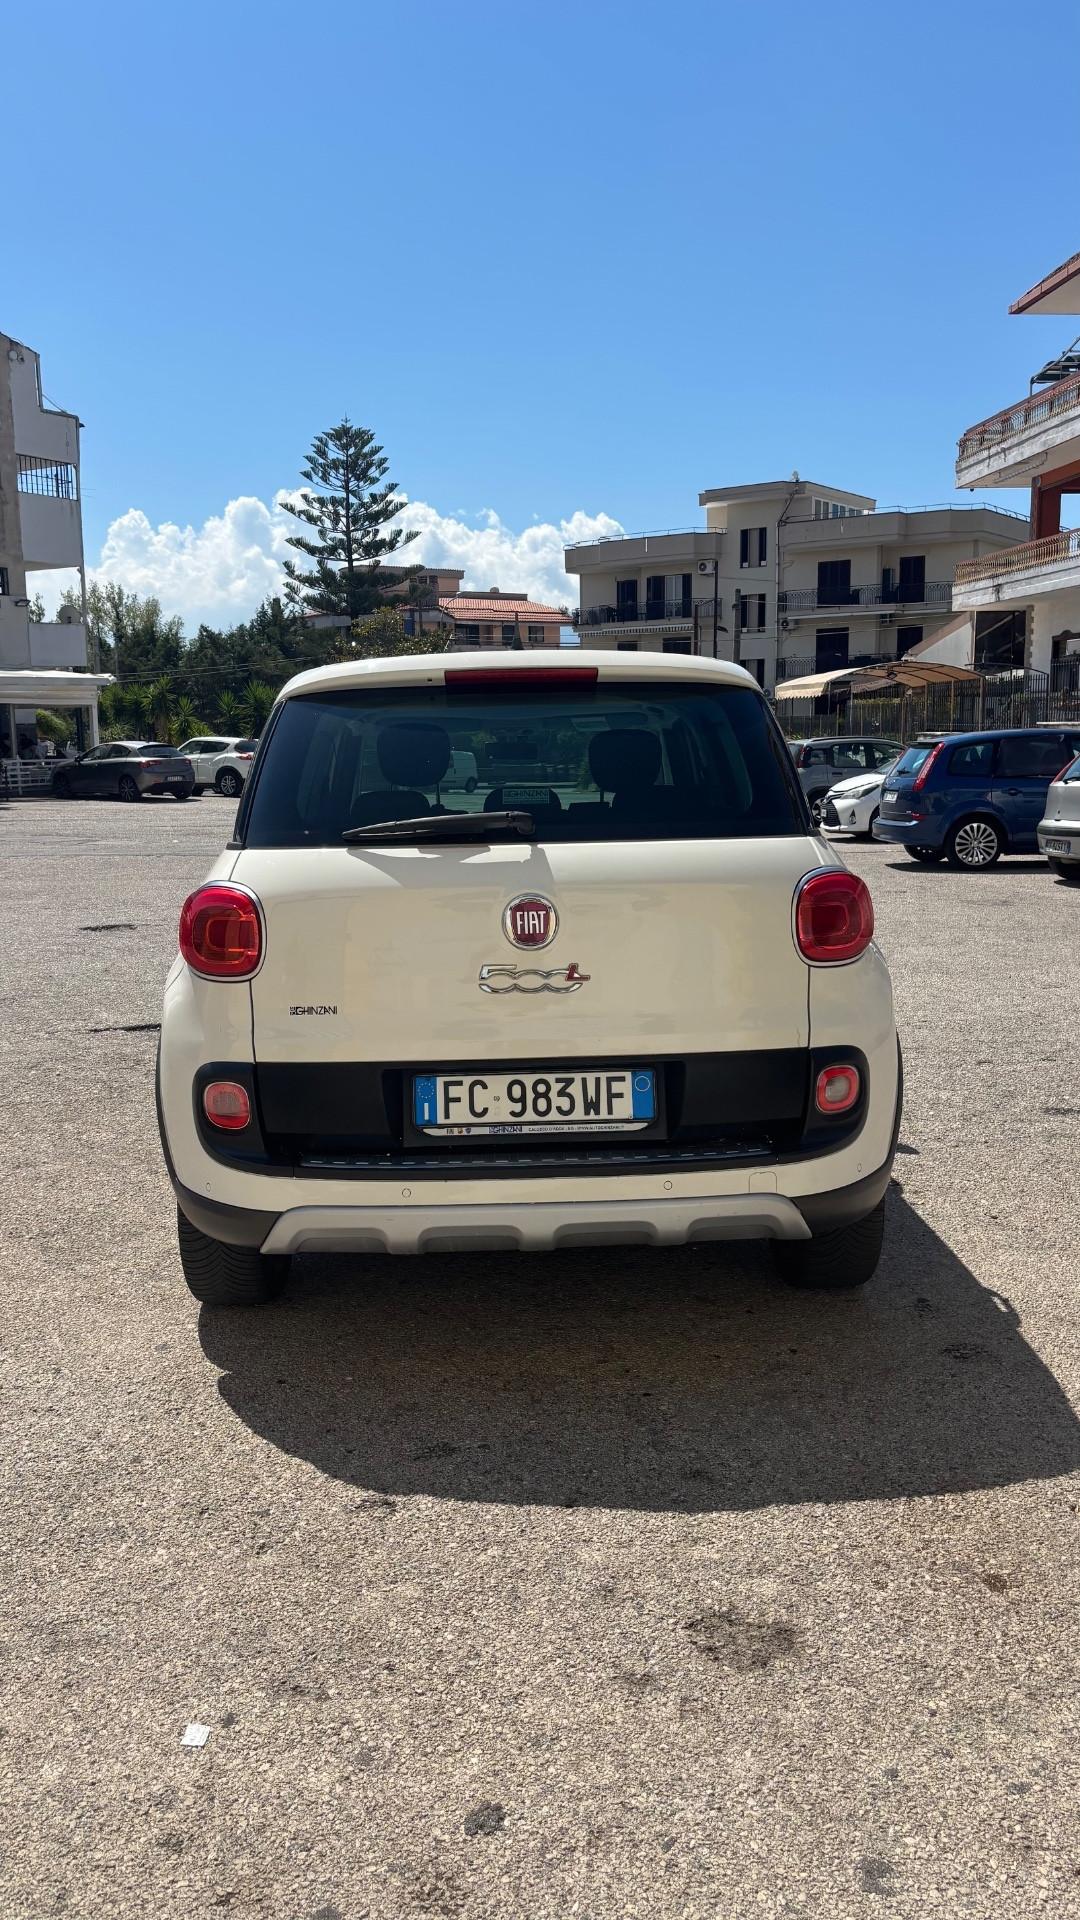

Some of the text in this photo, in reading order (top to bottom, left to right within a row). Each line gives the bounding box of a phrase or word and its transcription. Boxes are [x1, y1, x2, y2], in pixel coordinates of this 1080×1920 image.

[516, 911, 547, 934] FIAT
[479, 963, 591, 994] 500L
[295, 1006, 338, 1016] GHINZANI
[443, 1076, 626, 1120] FC 983WF
